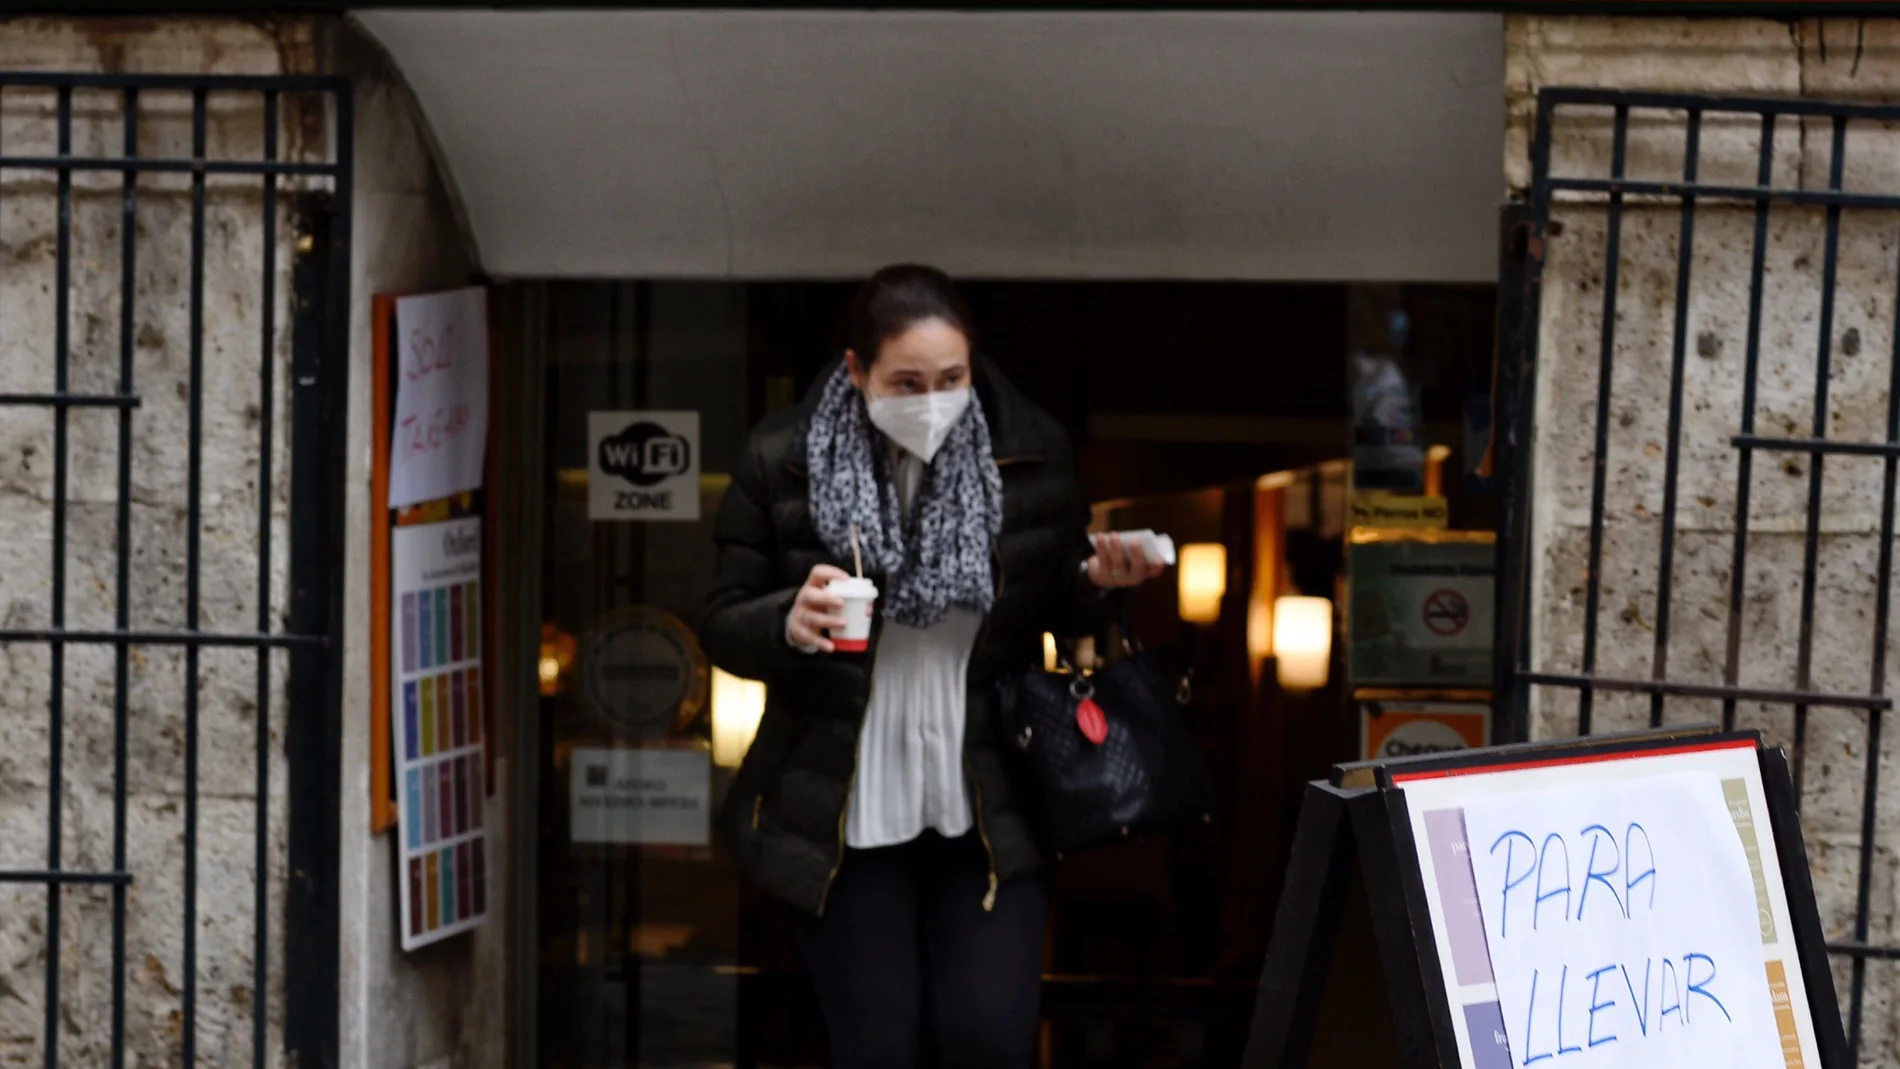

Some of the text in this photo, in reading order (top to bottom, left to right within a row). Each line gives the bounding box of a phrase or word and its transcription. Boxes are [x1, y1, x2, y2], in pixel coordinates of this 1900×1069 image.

[614, 490, 674, 511] ZONE
[1490, 822, 1656, 939] PARA
[1523, 952, 1732, 1066] LLEVAR
